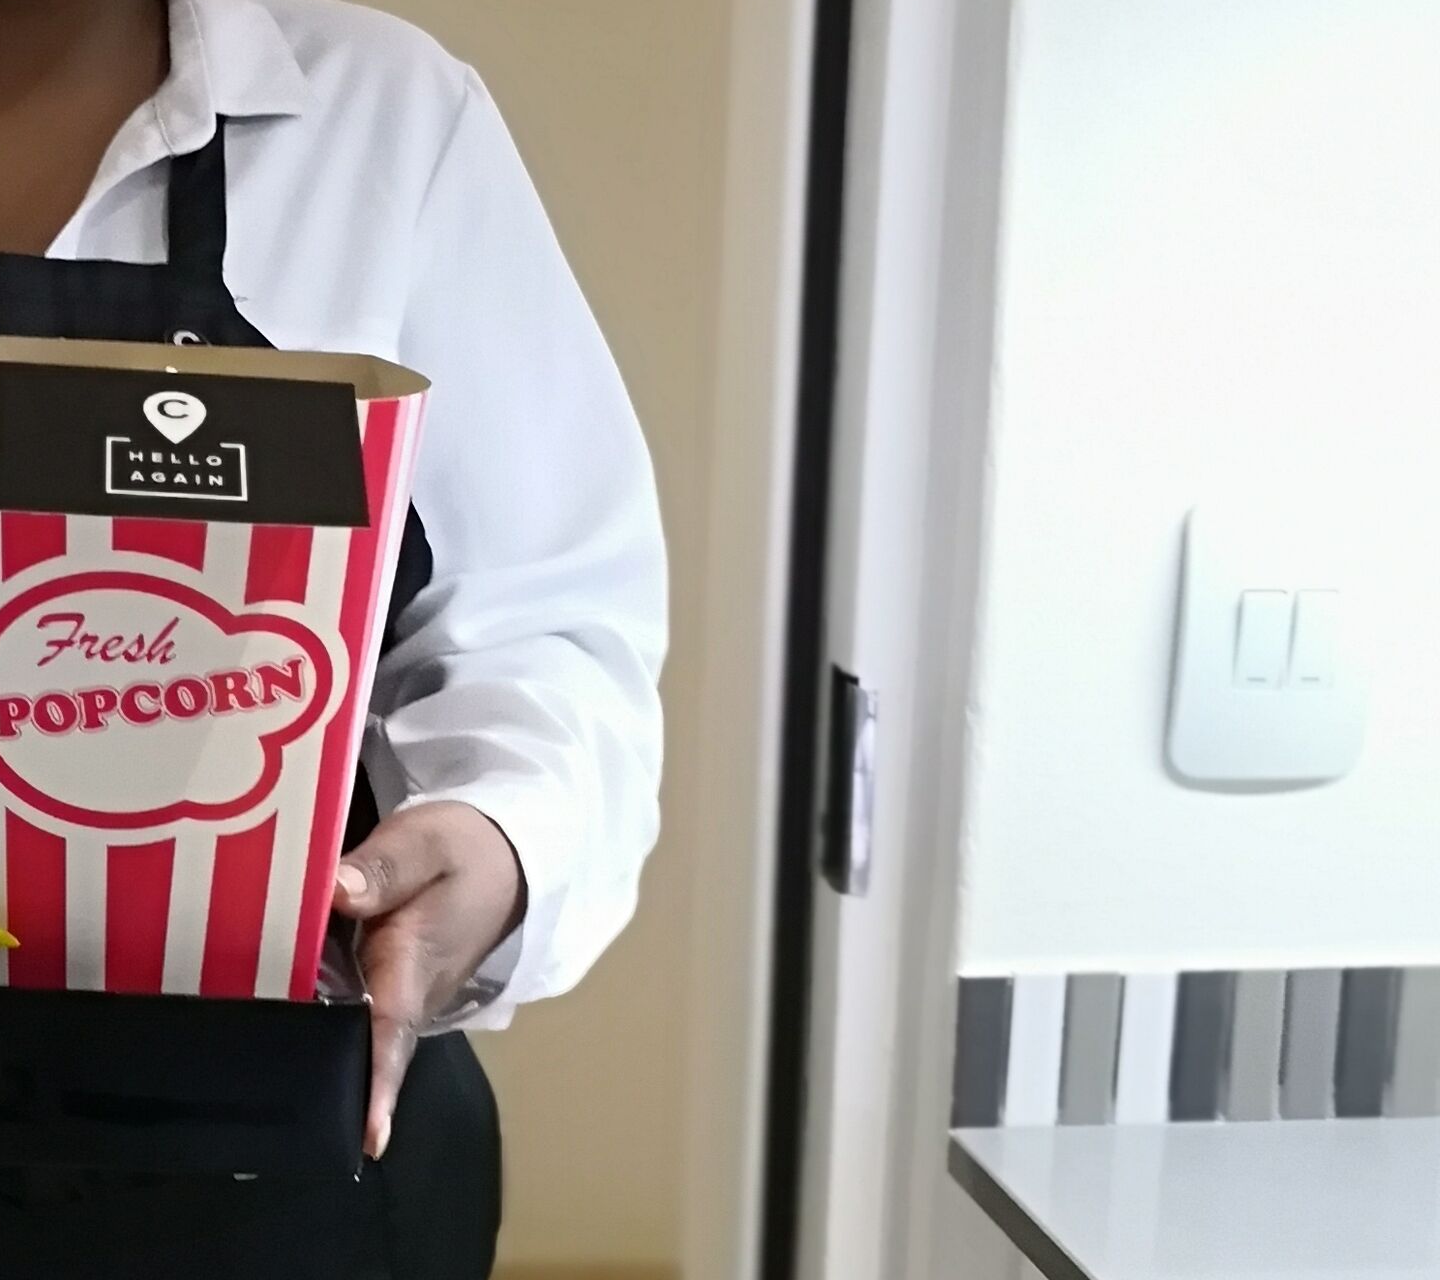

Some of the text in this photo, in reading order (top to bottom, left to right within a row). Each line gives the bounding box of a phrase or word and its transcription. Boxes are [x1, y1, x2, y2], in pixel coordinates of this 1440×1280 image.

[157, 398, 189, 419] C
[128, 450, 223, 467] HELLO
[129, 470, 224, 487] AGAIN
[37, 612, 181, 667] Fresh
